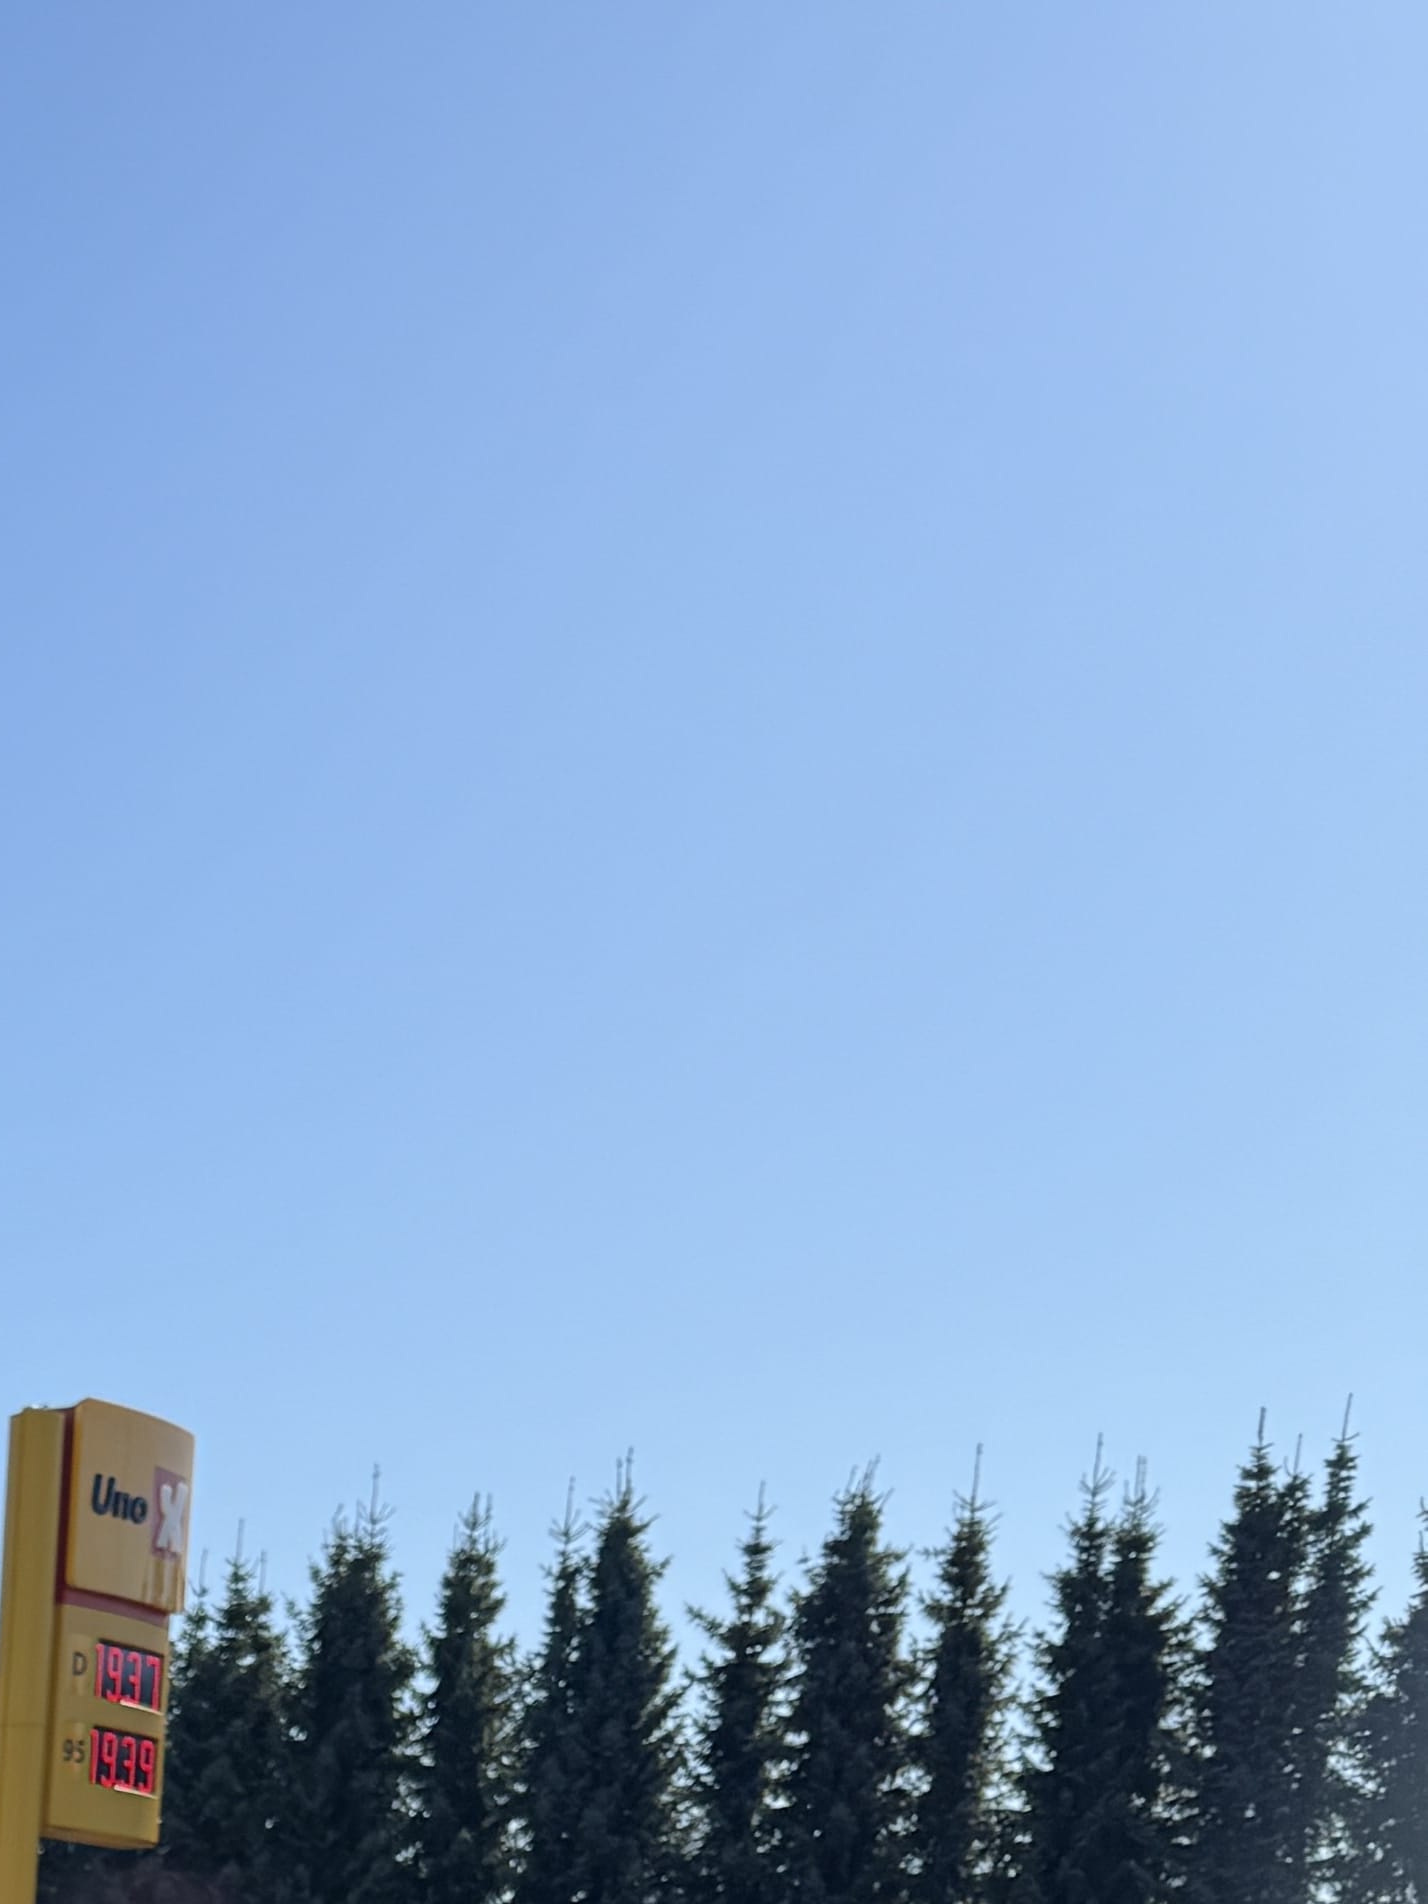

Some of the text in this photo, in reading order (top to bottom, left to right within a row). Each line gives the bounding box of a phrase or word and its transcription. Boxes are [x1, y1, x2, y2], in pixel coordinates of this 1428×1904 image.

[91, 1473, 189, 1553] Uno X
[72, 1652, 88, 1676] D
[63, 1739, 85, 1763] 95
